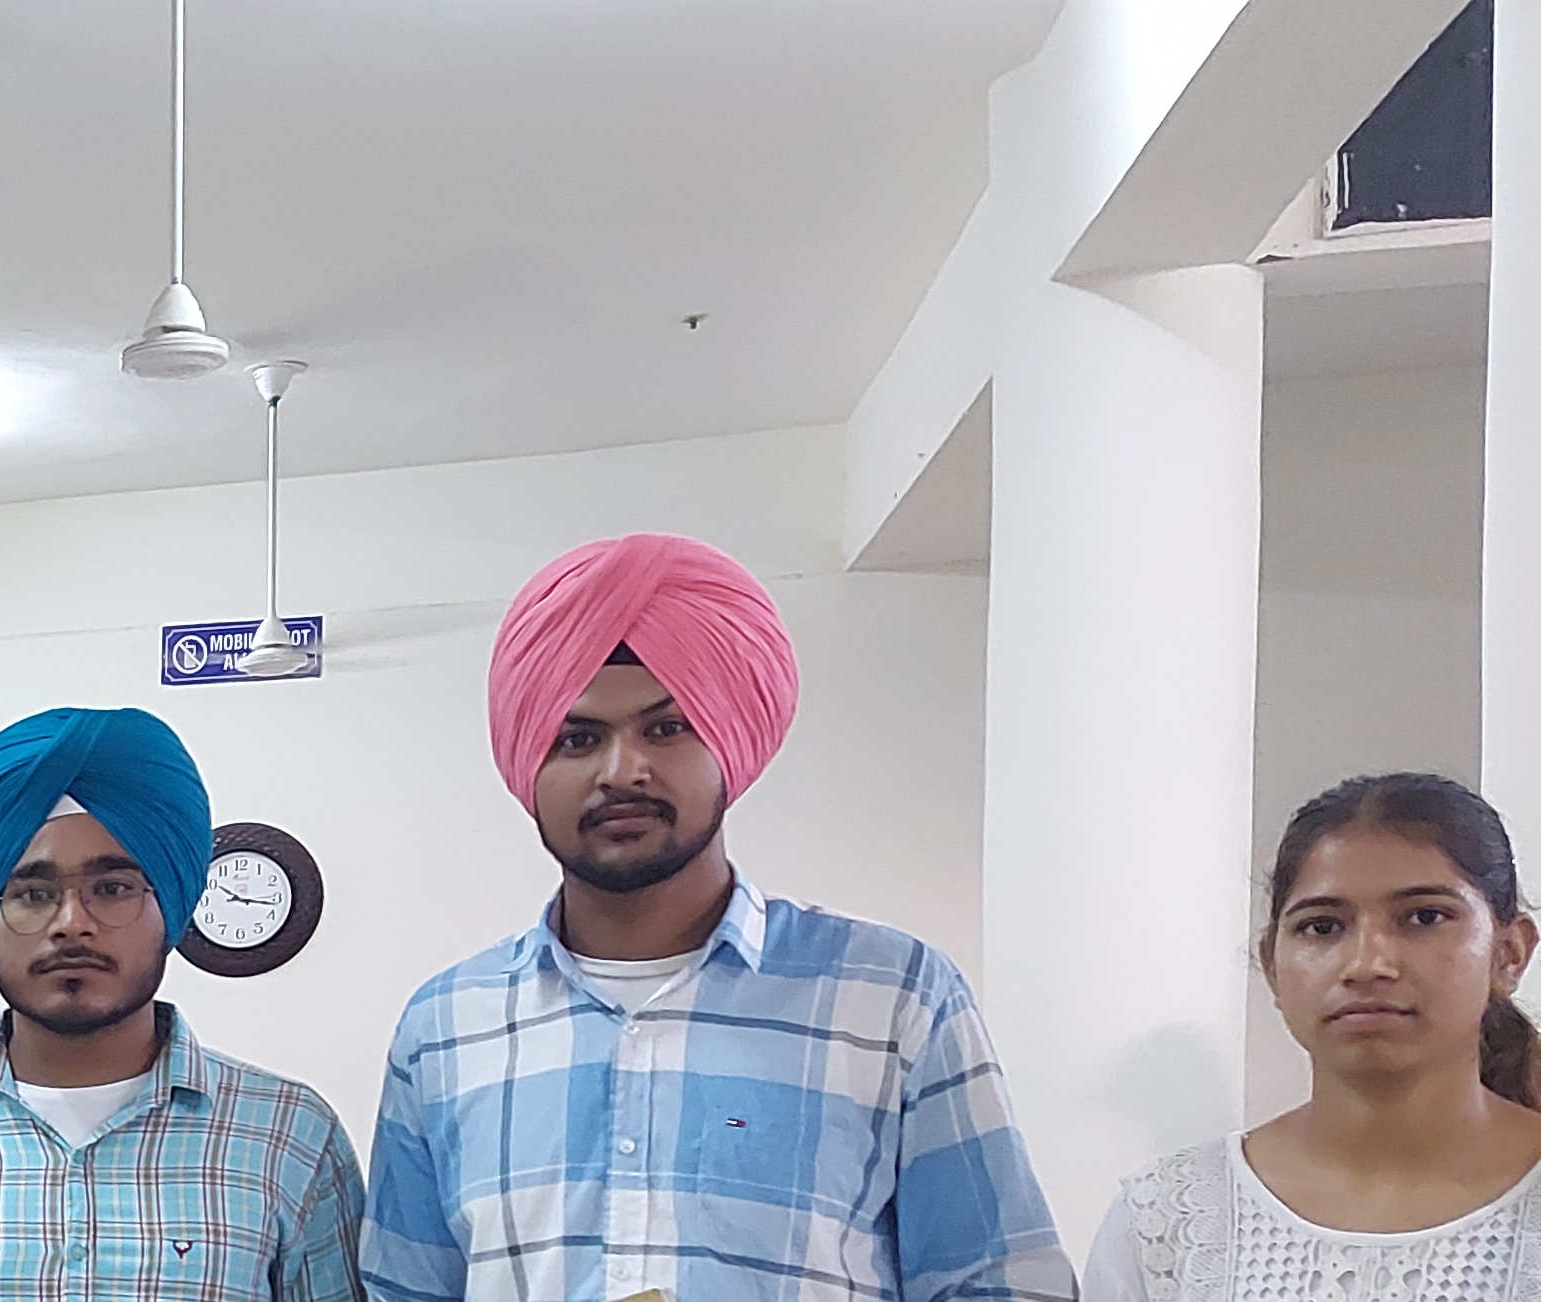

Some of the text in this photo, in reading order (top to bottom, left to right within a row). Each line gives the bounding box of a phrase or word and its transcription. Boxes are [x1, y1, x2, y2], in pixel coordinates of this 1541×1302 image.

[210, 629, 311, 652] MOBIL OT
[235, 859, 248, 871] 12
[219, 865, 228, 877] 11
[268, 875, 277, 886] 2
[205, 913, 214, 923] 8
[266, 909, 275, 920] 4
[218, 924, 227, 935] 7
[236, 928, 245, 939] 6
[253, 923, 263, 934] 5
